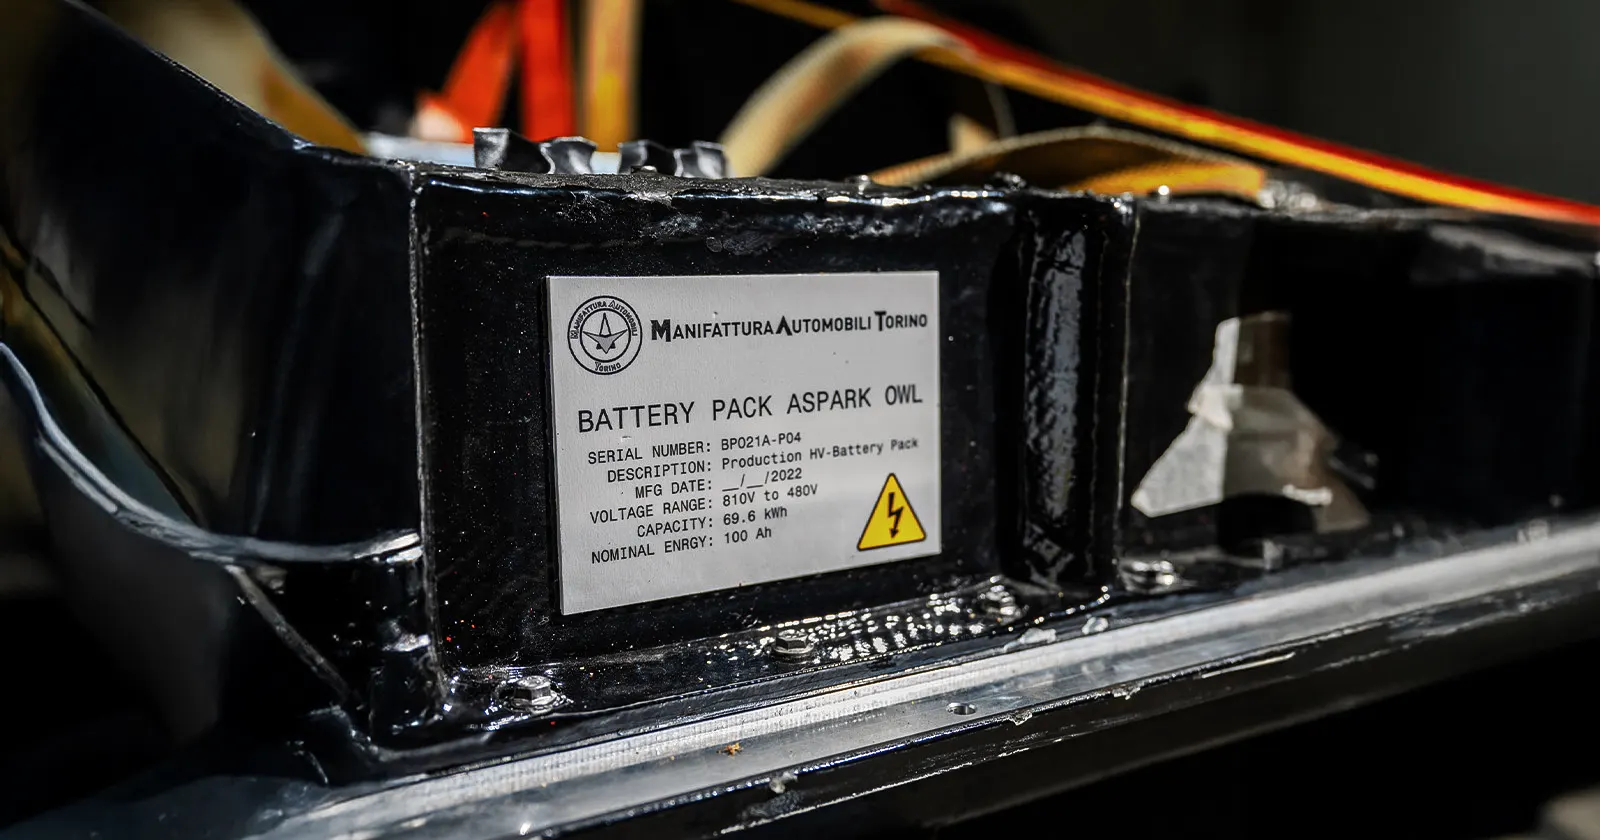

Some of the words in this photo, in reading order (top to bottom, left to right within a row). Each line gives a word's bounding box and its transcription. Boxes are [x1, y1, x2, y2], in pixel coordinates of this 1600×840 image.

[650, 317, 774, 343] MANIFATTURA
[775, 313, 872, 337] AUTOMOBILI
[873, 310, 928, 332] TORINO
[577, 401, 695, 434] BATTERY
[712, 396, 774, 424] PACK
[786, 387, 872, 415] ASPARK
[884, 383, 924, 406] OWL
[587, 447, 644, 465] SERIAL
[651, 441, 711, 461] NUMBER:
[607, 459, 711, 483] DESCRIPTION:
[721, 451, 803, 475] Production
[809, 444, 884, 464] HV-Battery
[889, 438, 920, 451] Pack
[589, 505, 654, 525] VOLTAGE
[662, 496, 712, 517] RANGE:
[722, 491, 756, 508] 810V
[763, 490, 779, 502] to
[786, 483, 818, 499] 480V
[634, 484, 663, 500] MFG
[670, 477, 712, 496] DATE:
[636, 515, 712, 538] CAPACITY:
[723, 509, 756, 526] 69.6
[763, 505, 788, 521] kWh
[591, 542, 656, 566] NOMINAL
[664, 534, 713, 554] ENRGY:
[724, 529, 749, 545] 100
[755, 525, 773, 540] Ah
